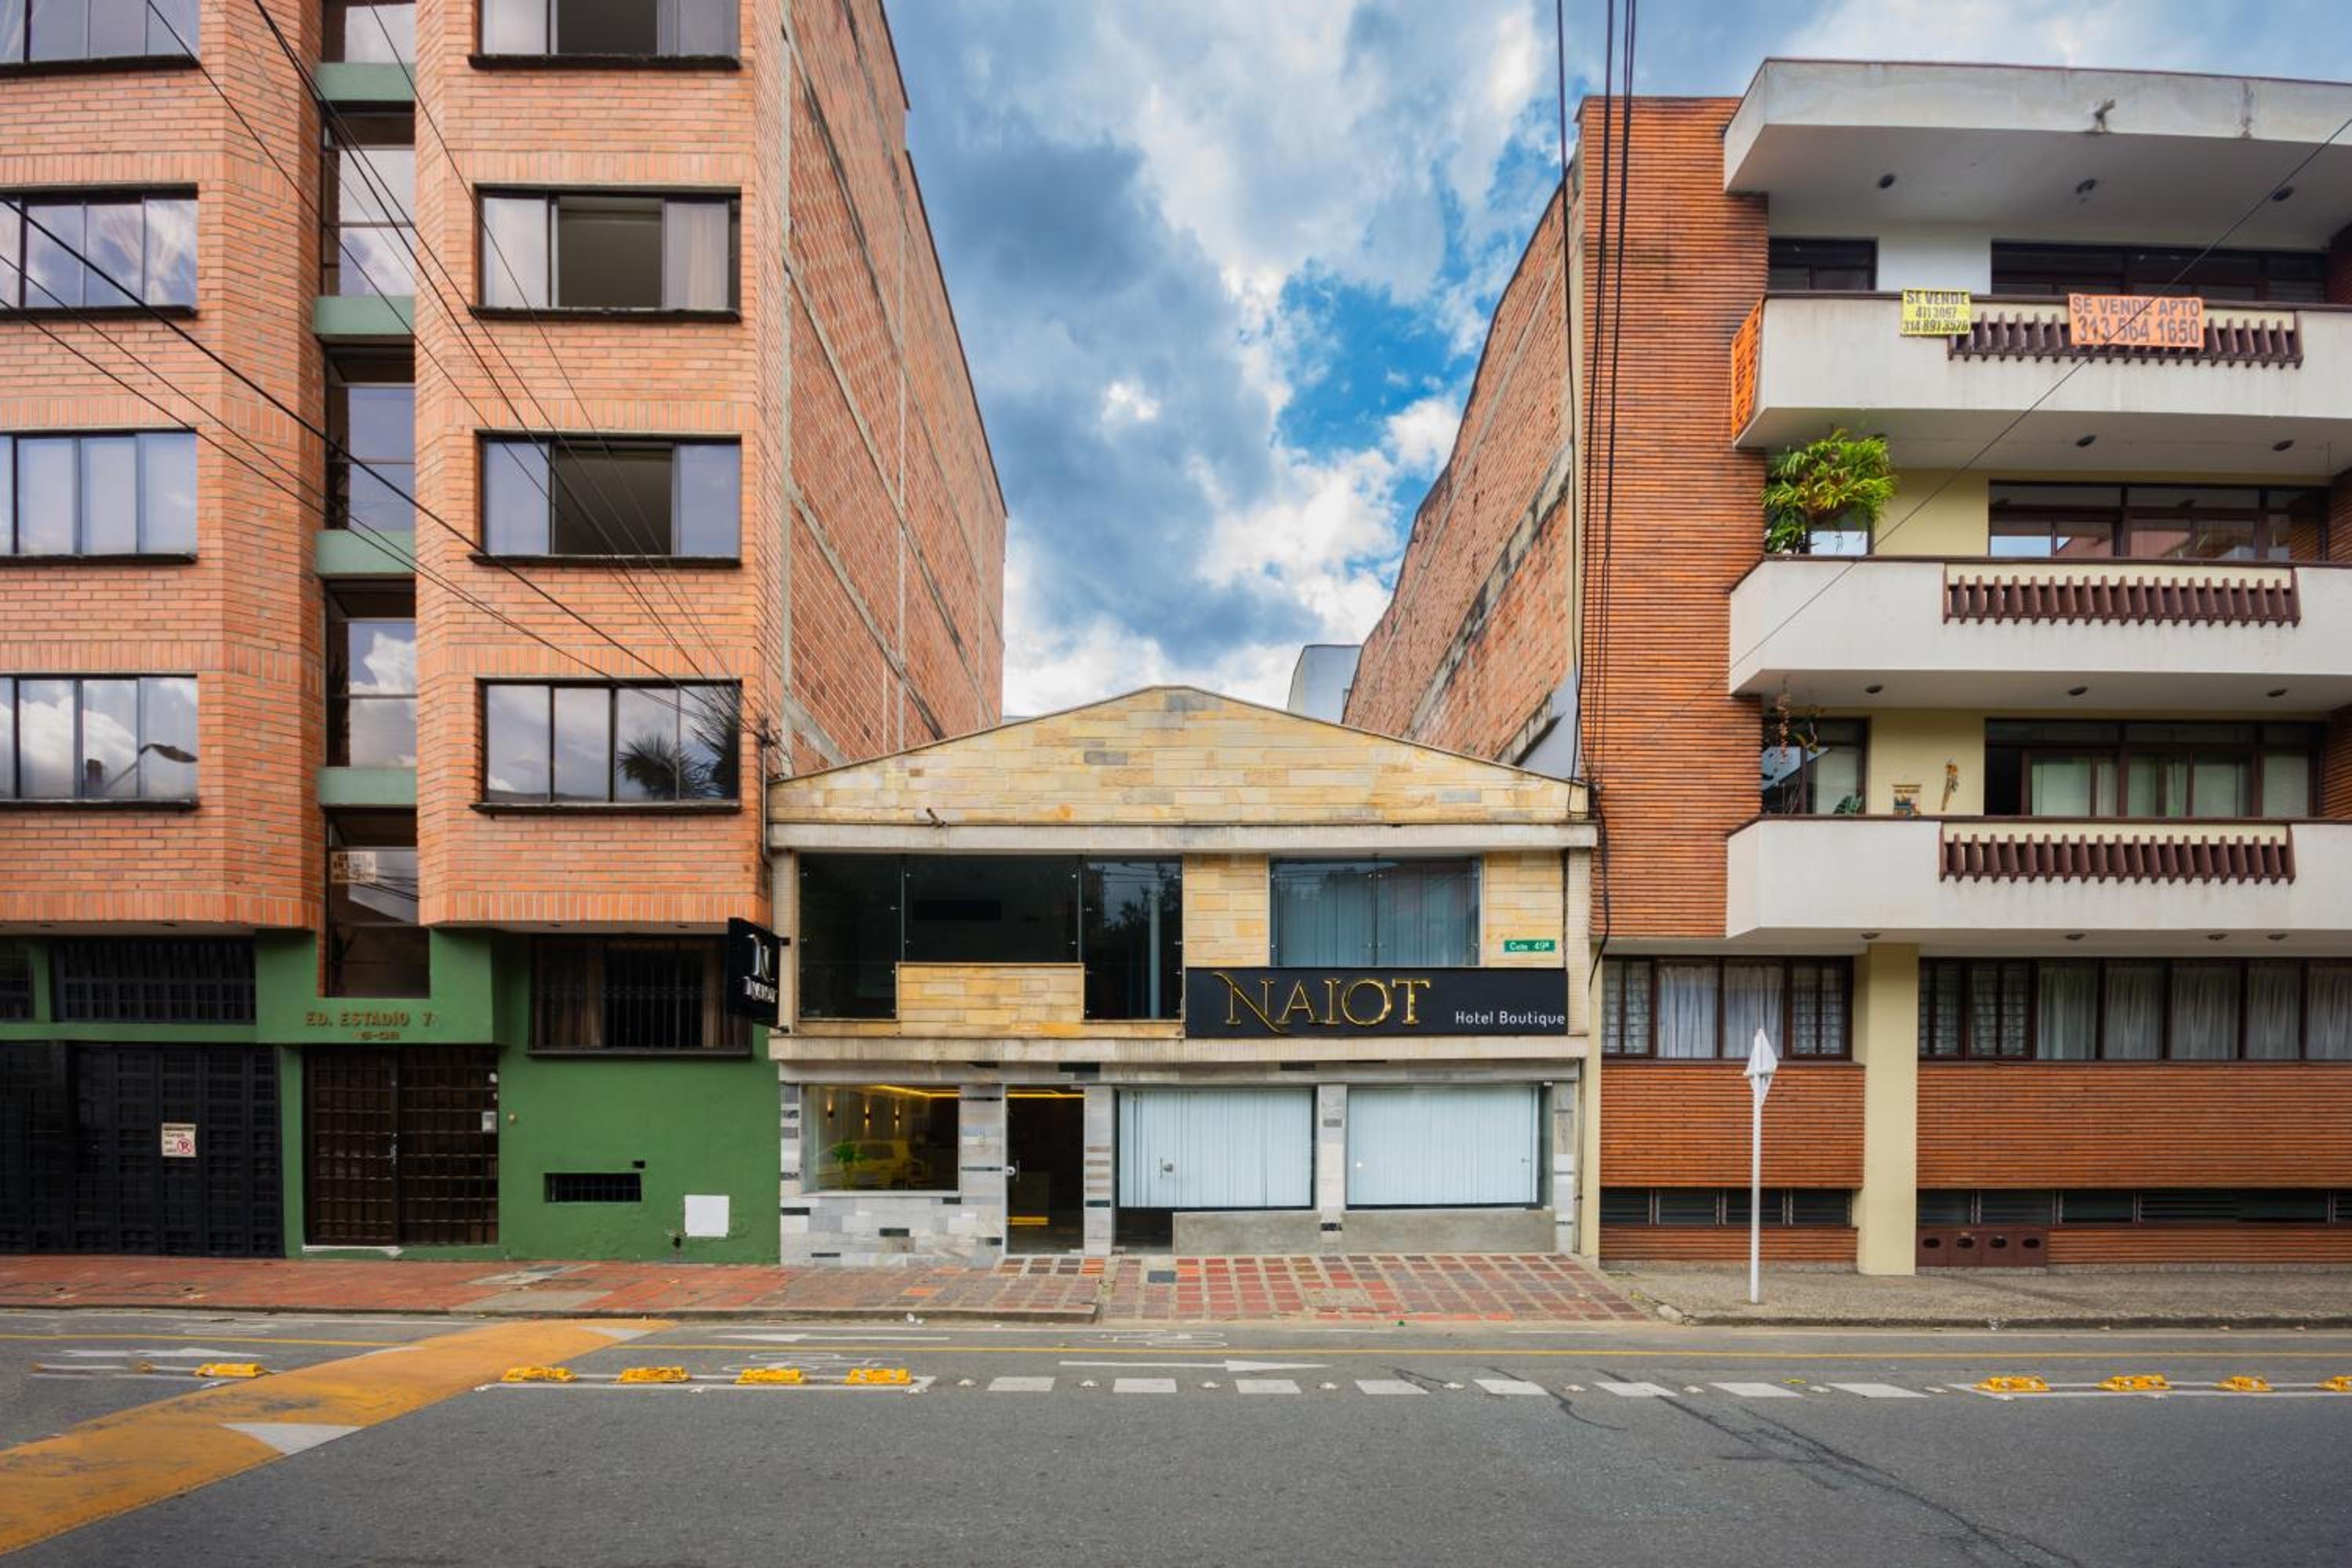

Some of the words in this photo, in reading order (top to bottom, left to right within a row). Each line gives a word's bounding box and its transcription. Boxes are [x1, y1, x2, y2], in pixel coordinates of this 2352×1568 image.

[1906, 290, 1922, 304] SE
[1925, 291, 1968, 305] VENDE
[2071, 296, 2092, 314] SE
[2099, 297, 2152, 315] VENDE
[2158, 299, 2200, 317] APTO
[2078, 315, 2110, 342] 313
[2157, 318, 2199, 344] 1650
[1213, 971, 1432, 1034] NAIOT
[339, 1011, 412, 1027] ESTADIO
[1455, 1011, 1494, 1025] Hotel
[1499, 1011, 1566, 1028] Boutique
